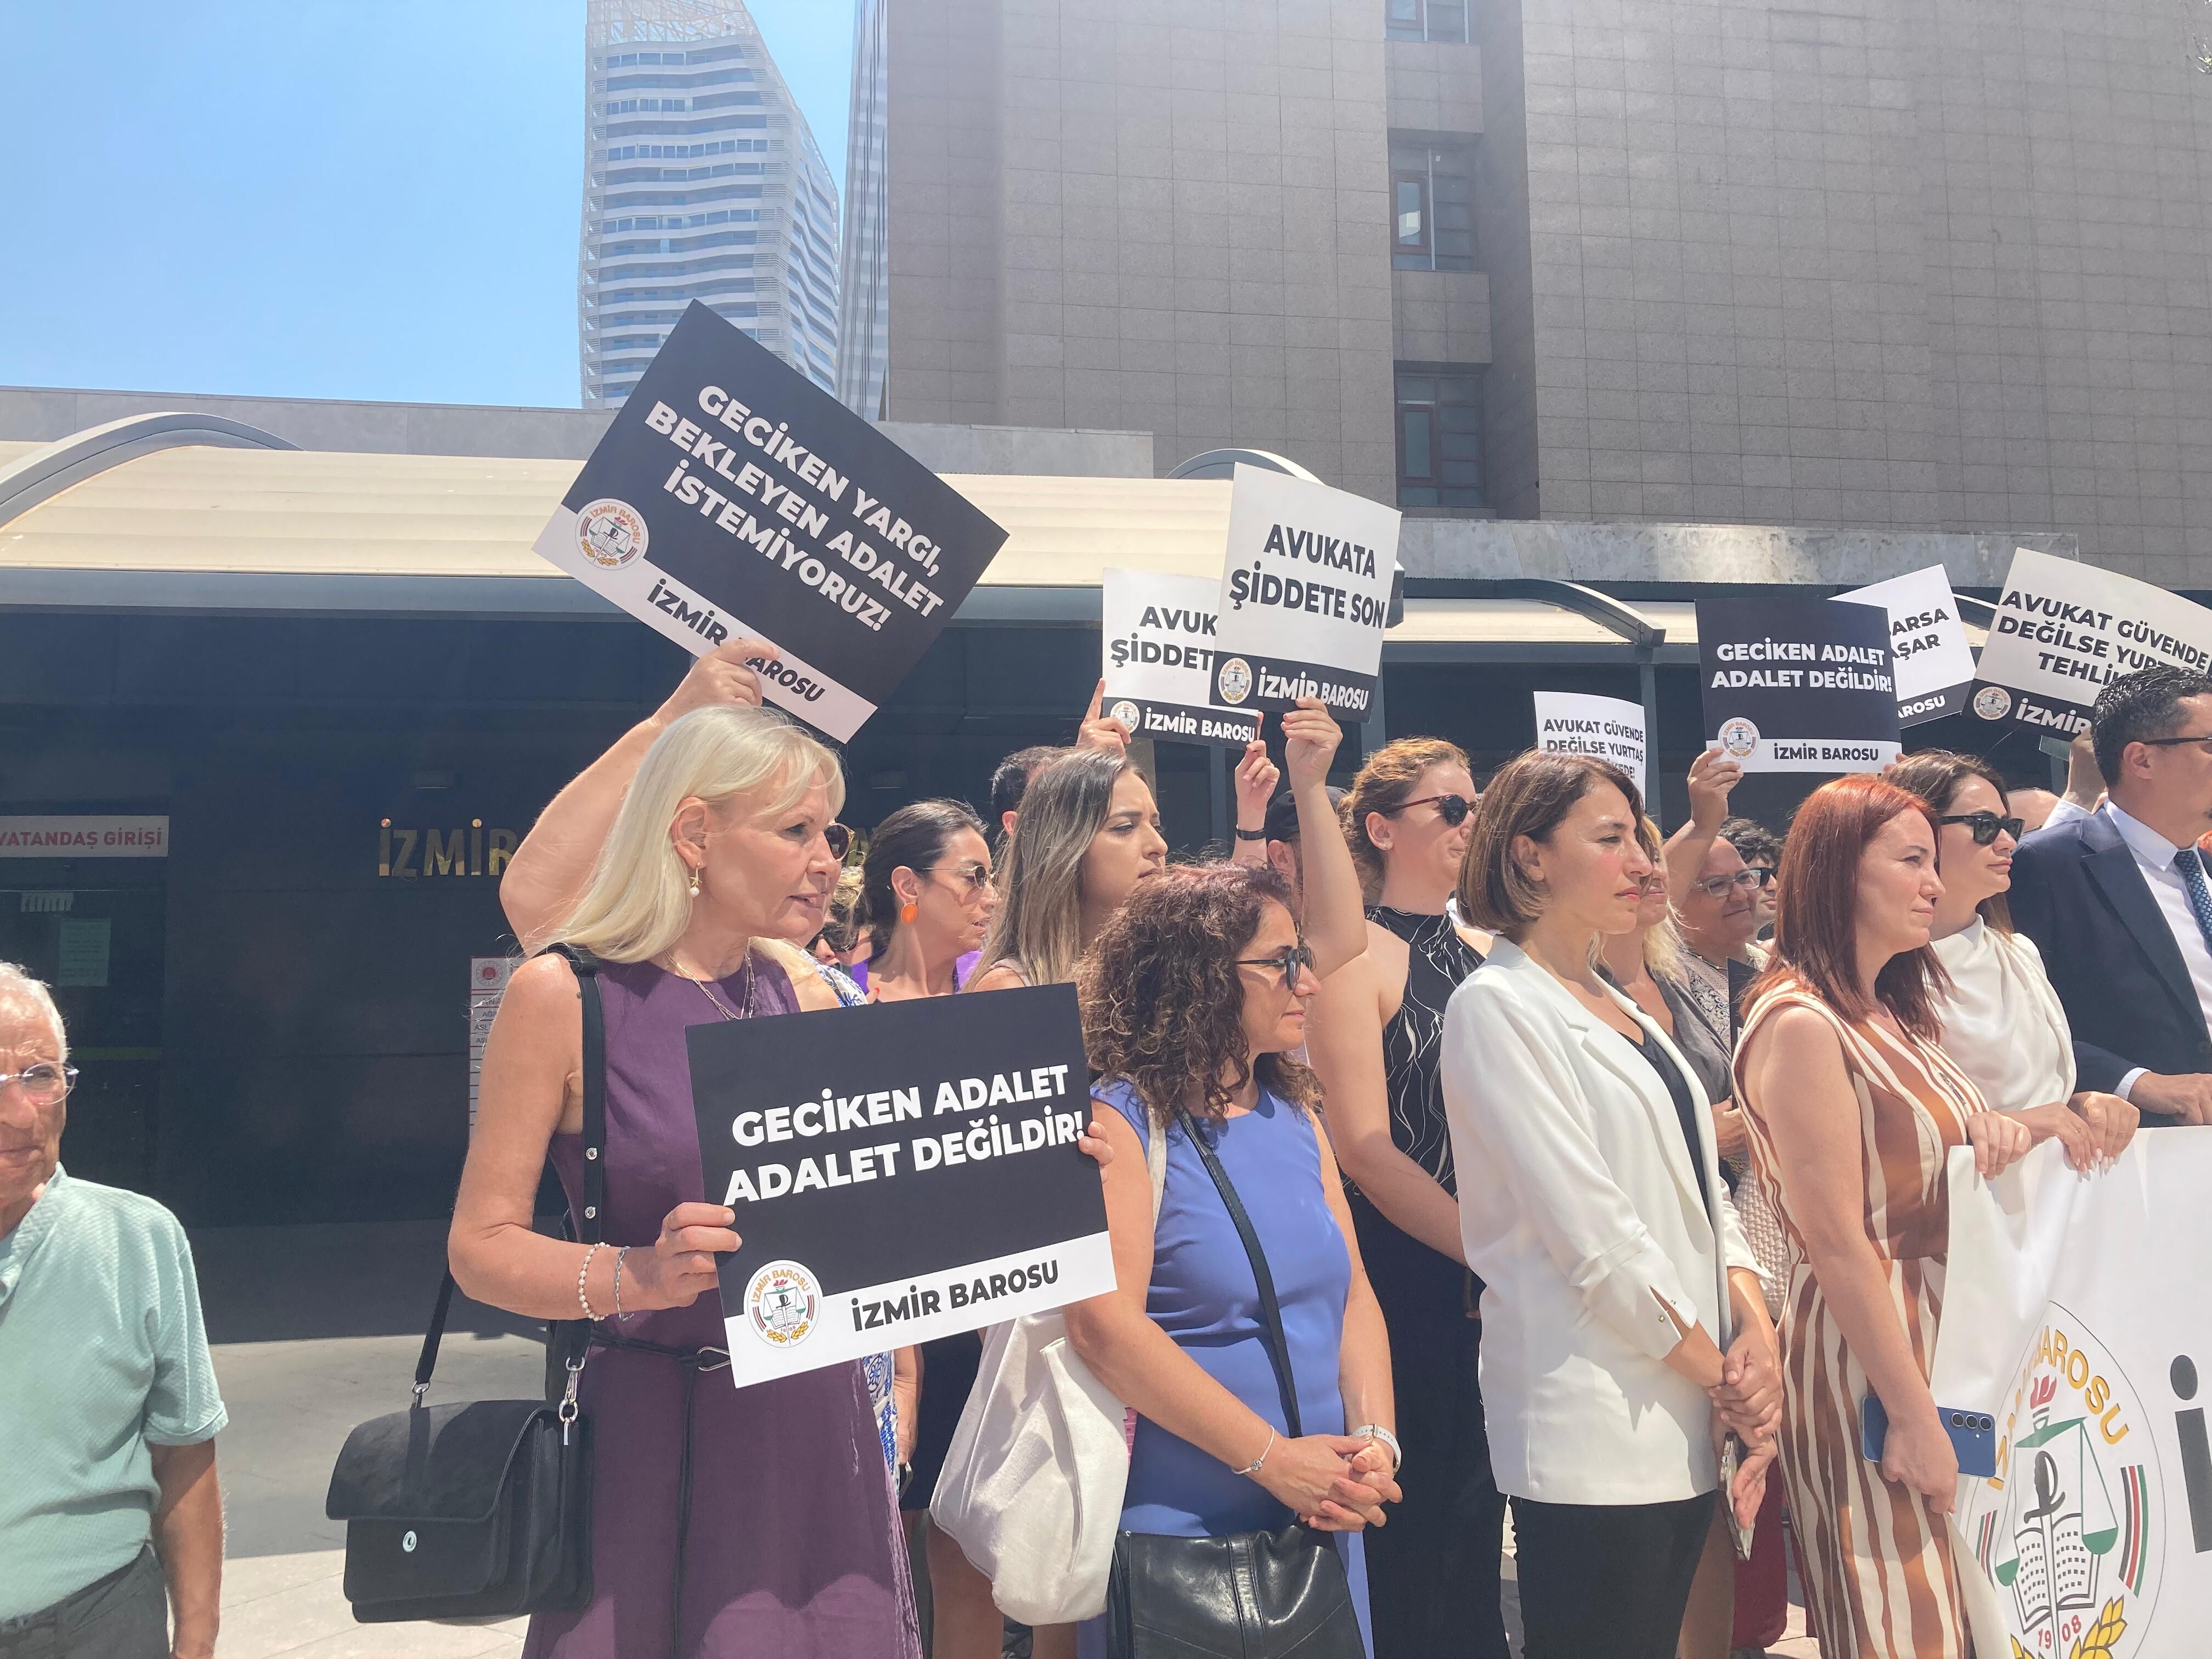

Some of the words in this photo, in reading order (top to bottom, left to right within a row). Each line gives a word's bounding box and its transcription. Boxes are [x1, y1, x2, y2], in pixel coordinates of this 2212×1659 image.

[698, 385, 849, 503] GECİKEN
[851, 487, 941, 577] YARGI,
[645, 400, 829, 539] BEKLEYEN
[826, 529, 944, 617] ADALET
[664, 459, 893, 631] İSTEMİYORUZ!
[1263, 524, 1375, 579] AVUKATA
[1229, 561, 1346, 619] ŞİDDETE
[1350, 593, 1385, 629] SON
[647, 578, 728, 647] İZMİR
[744, 657, 825, 701] AROSU
[1139, 606, 1218, 636] AVUK
[1997, 616, 2109, 658] DEĞİLSE
[2117, 645, 2167, 670] YUR
[2001, 590, 2113, 630] AVUKAT
[2118, 620, 2209, 670] GÜVENDE
[1110, 633, 1214, 671] ŞİDDET
[1717, 637, 1816, 662] GECİKEN
[1821, 645, 1885, 666] ADALET
[1257, 666, 1318, 700] İZMİR
[1321, 682, 1369, 710] BAROSU
[1711, 670, 1804, 689] ADALET
[1809, 667, 1893, 693] DEĞİLDİR!
[1144, 707, 1197, 735] İZMİR
[1201, 720, 1255, 743] BAROSU
[1544, 719, 1600, 733] AVUKAT
[1604, 720, 1644, 743] GÜVENDE
[2016, 698, 2092, 734] İZMİR
[1547, 736, 1606, 754] DEĞİLSE
[1608, 742, 1643, 766] YURTTAŞ
[1774, 743, 1818, 760] İZMİR
[1822, 747, 1879, 761] BAROSU
[104, 827, 162, 849] GİRİŞİ
[379, 818, 518, 877] İZMİR
[732, 1088, 922, 1147] GECİKEN
[933, 1064, 1068, 1115] ADALET
[723, 1143, 900, 1206] ADALET
[912, 1105, 1085, 1171] DEĞİLDİR!
[772, 1269, 810, 1291] BAROSU
[853, 1284, 940, 1333] İZMİR
[950, 1259, 1059, 1309] BAROSU
